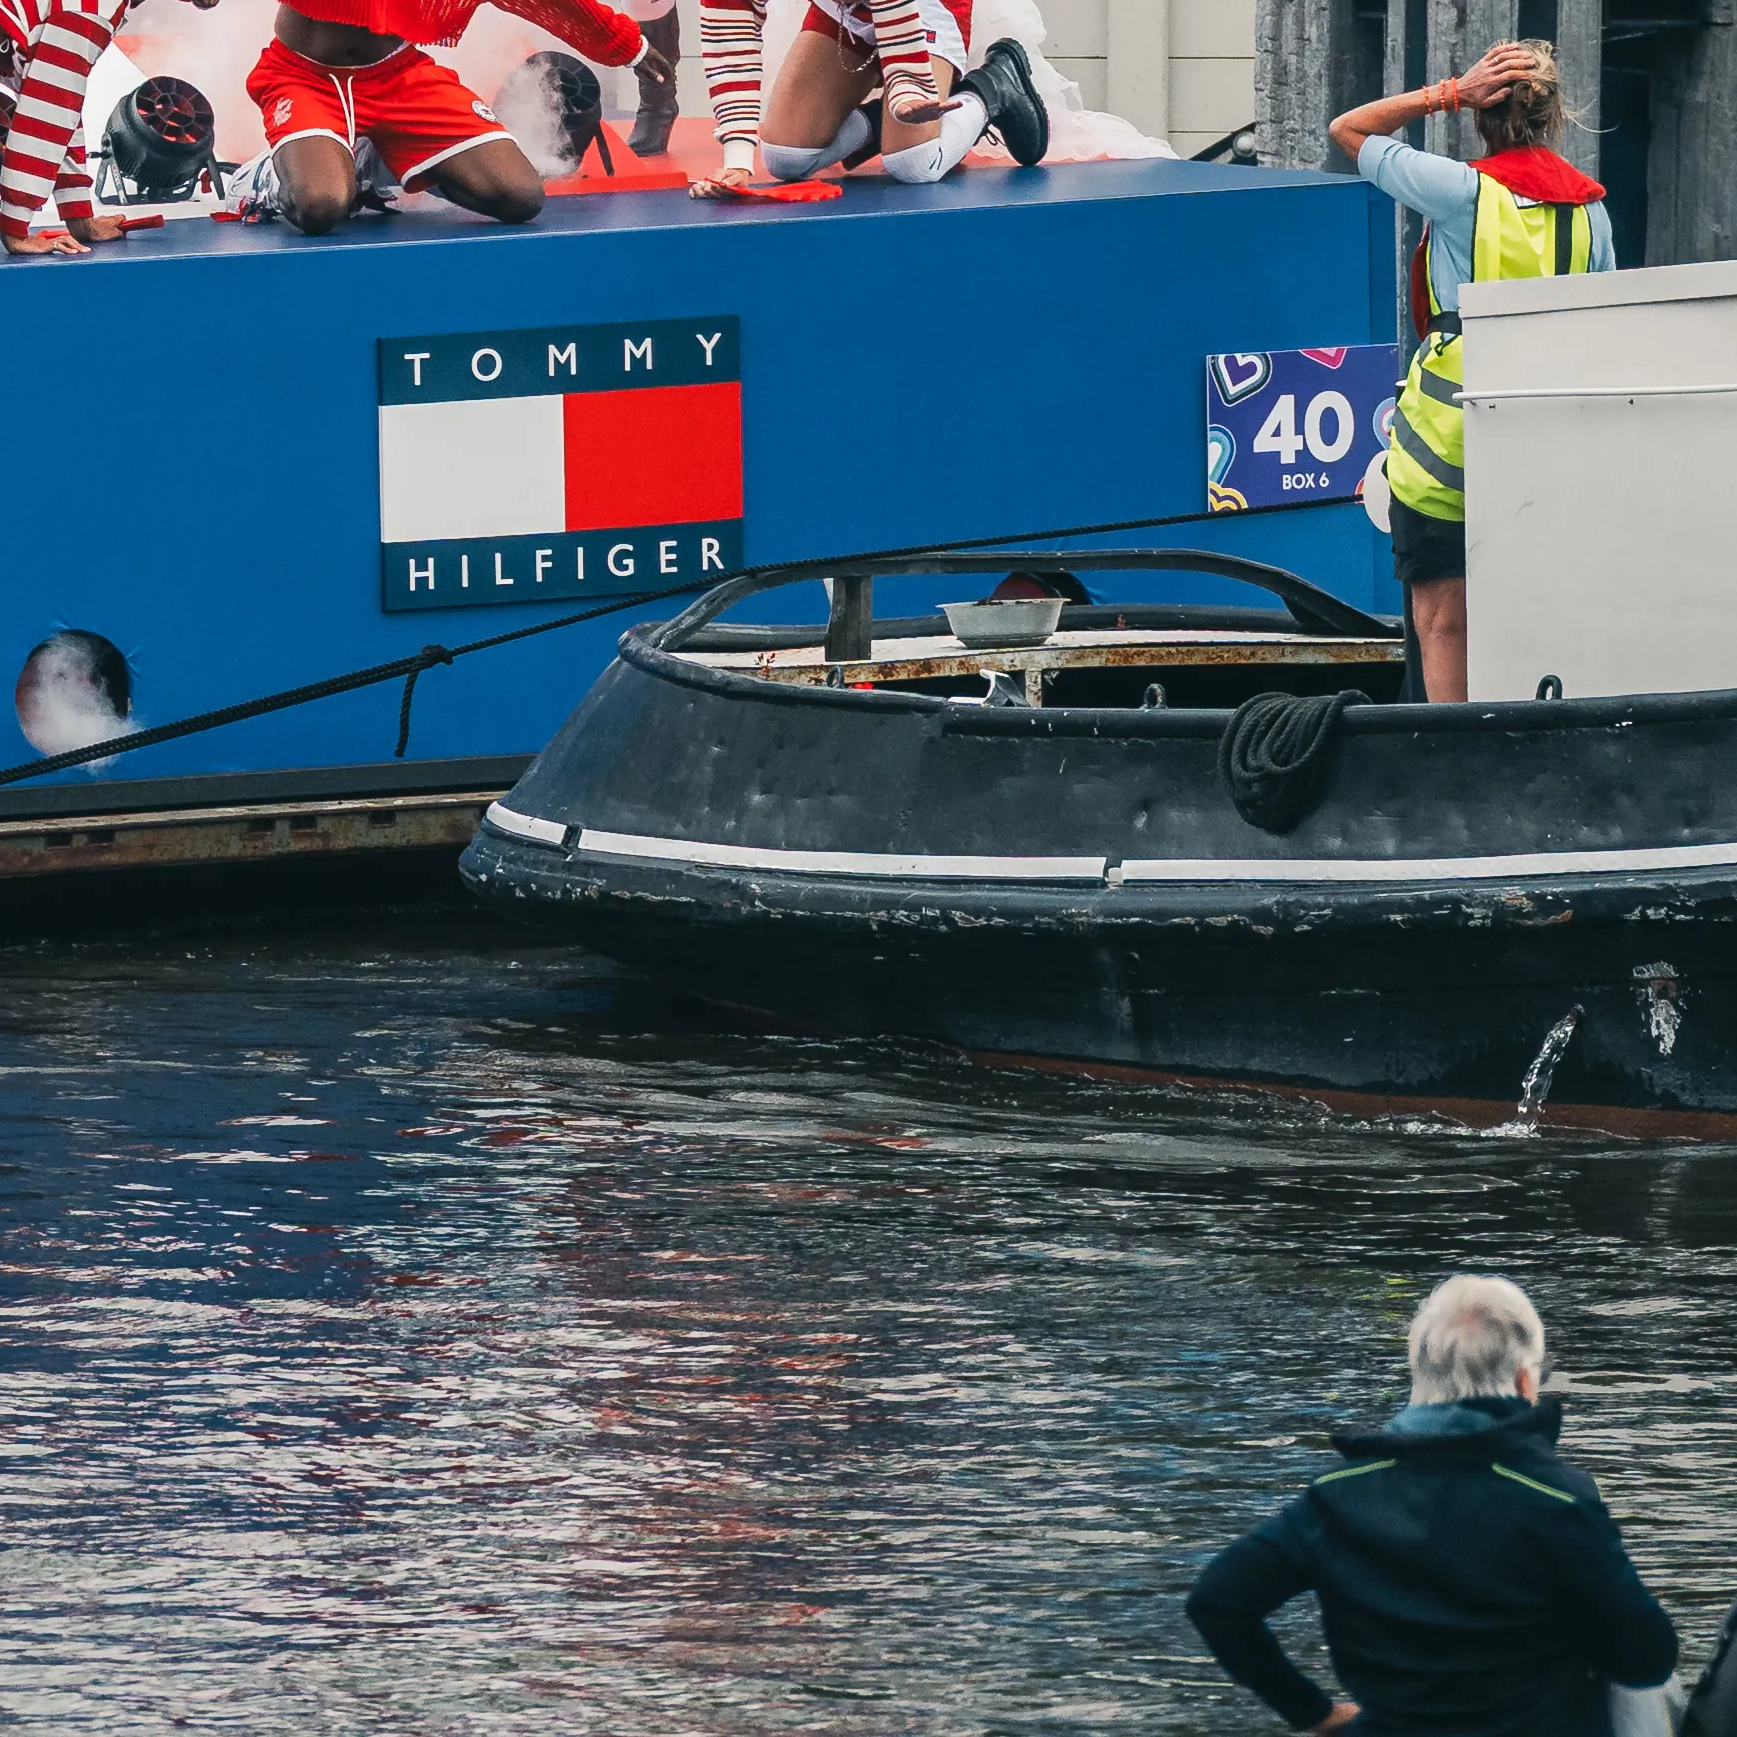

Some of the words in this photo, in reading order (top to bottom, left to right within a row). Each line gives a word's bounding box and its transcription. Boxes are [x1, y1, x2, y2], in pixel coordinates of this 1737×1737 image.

[404, 333, 722, 386] TOMMY
[1253, 390, 1354, 464] 40
[1282, 473, 1315, 490] BOX
[1319, 472, 1330, 488] 6
[409, 538, 725, 591] HILFIGER
